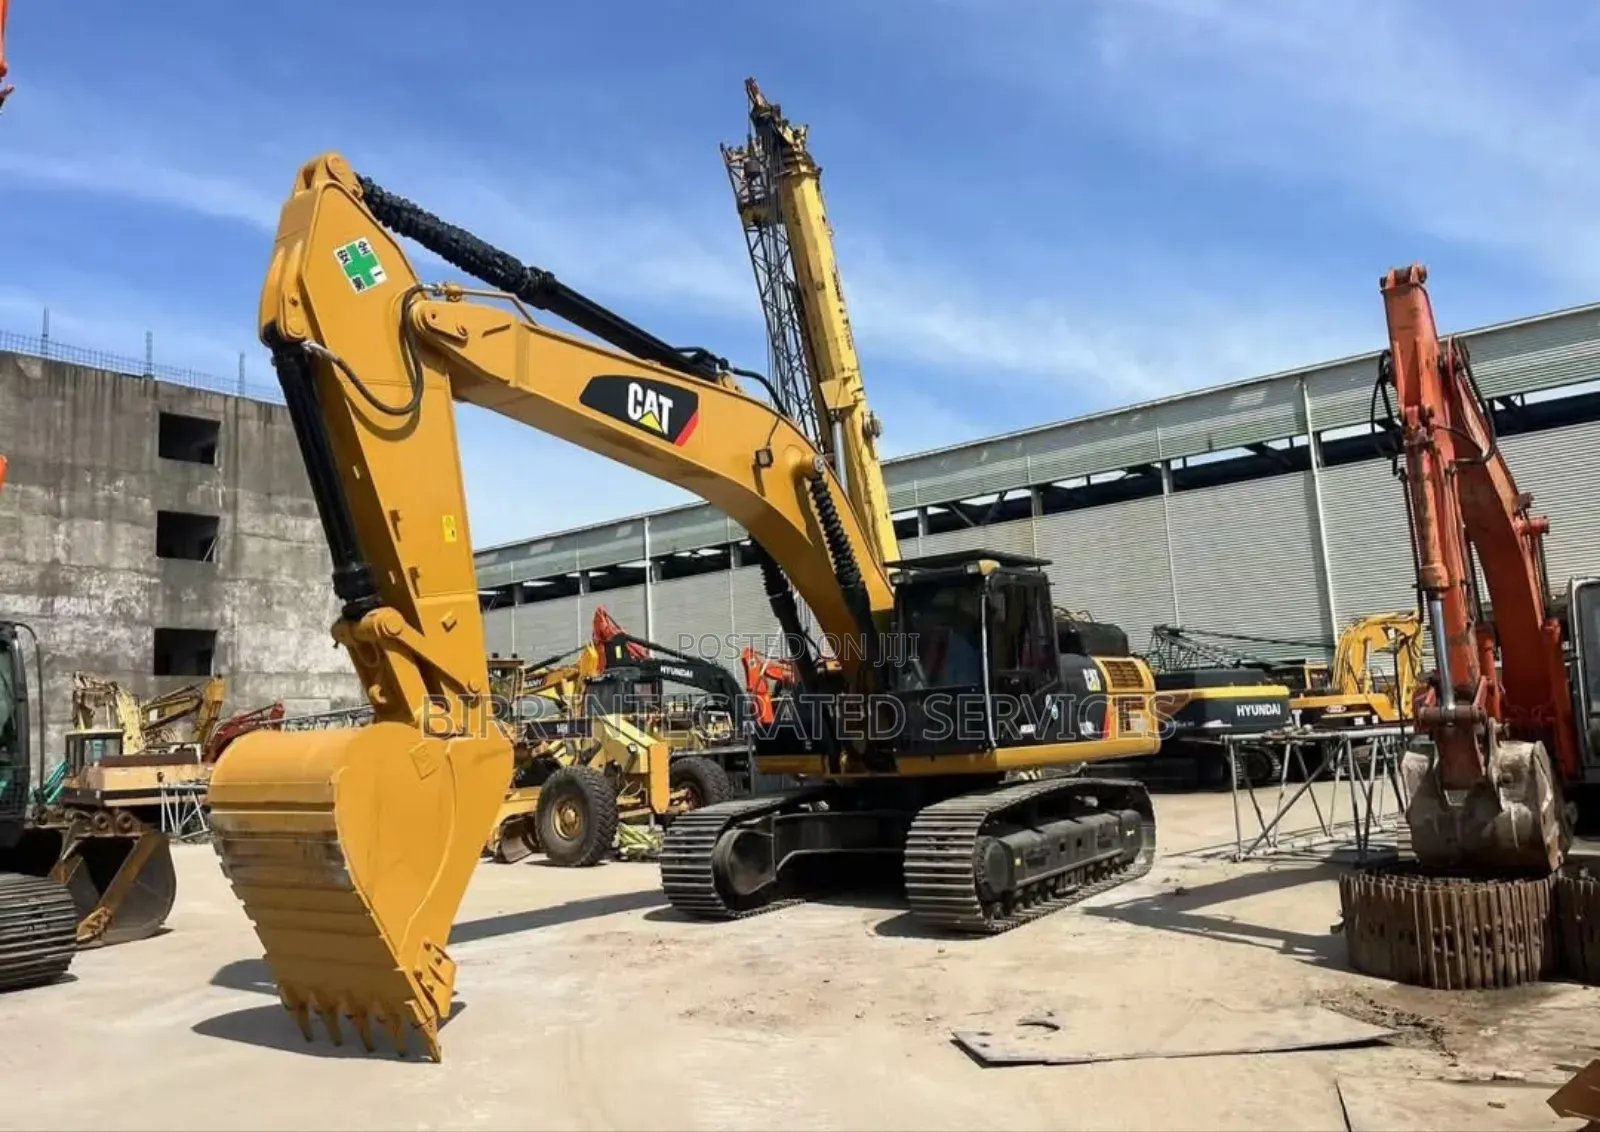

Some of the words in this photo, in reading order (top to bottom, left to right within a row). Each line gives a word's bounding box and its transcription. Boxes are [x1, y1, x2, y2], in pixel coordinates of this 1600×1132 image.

[627, 382, 673, 434] CAT
[660, 665, 693, 678] HYUNDAI
[1082, 668, 1101, 691] CAT
[1236, 703, 1281, 717] HYUNDAI
